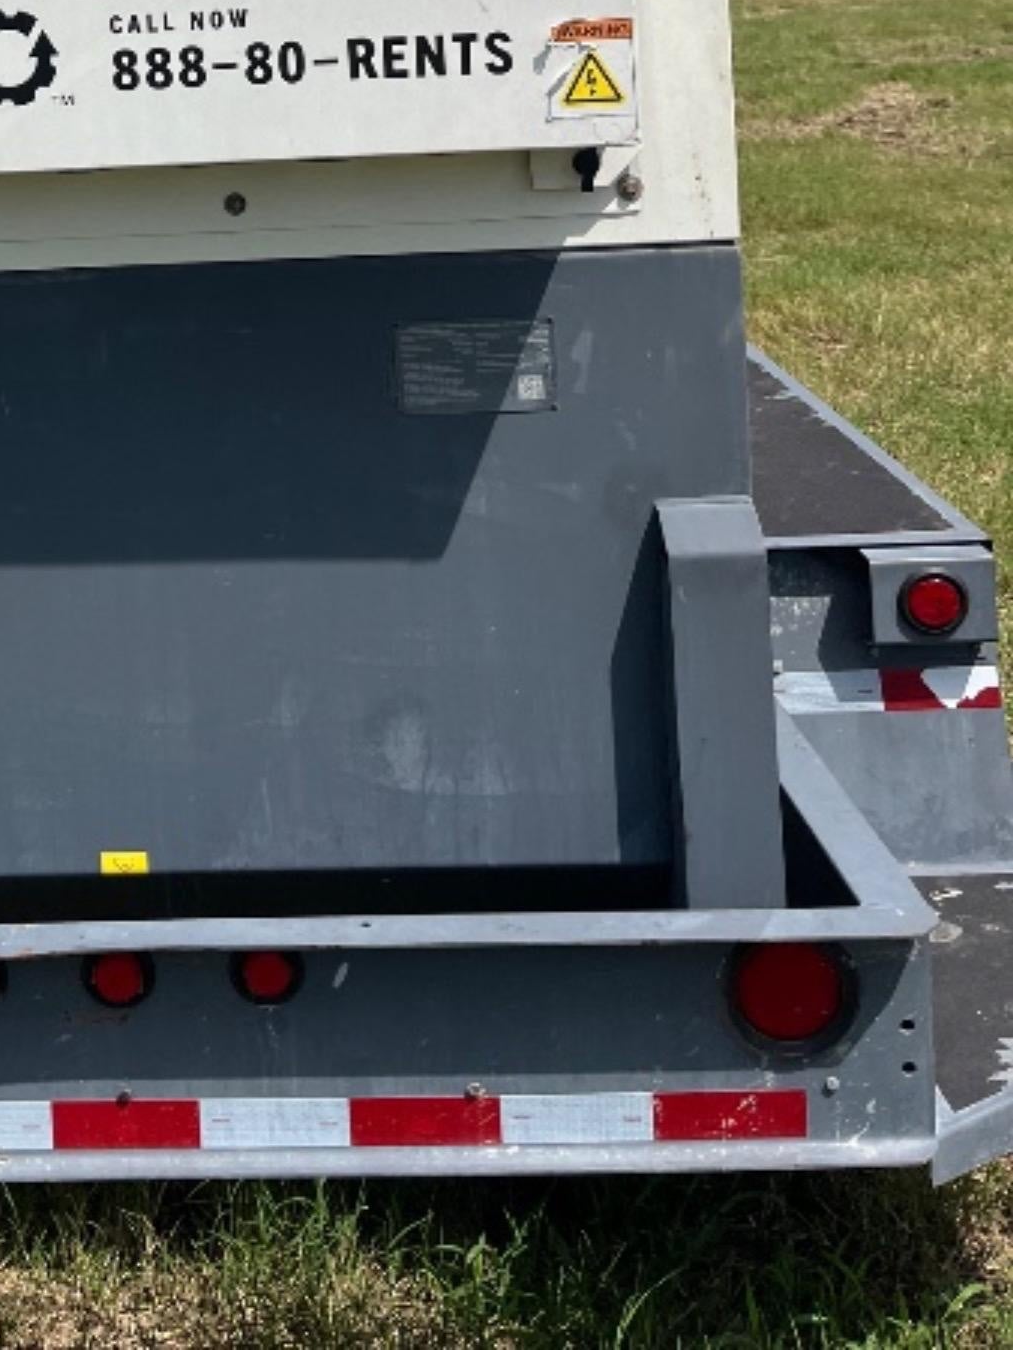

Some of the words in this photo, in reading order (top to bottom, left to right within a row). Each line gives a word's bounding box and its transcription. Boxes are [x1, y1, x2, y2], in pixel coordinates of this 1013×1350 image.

[109, 12, 176, 35] CALL
[189, 8, 249, 32] NOW
[111, 29, 514, 92] 888-80-RENTS
